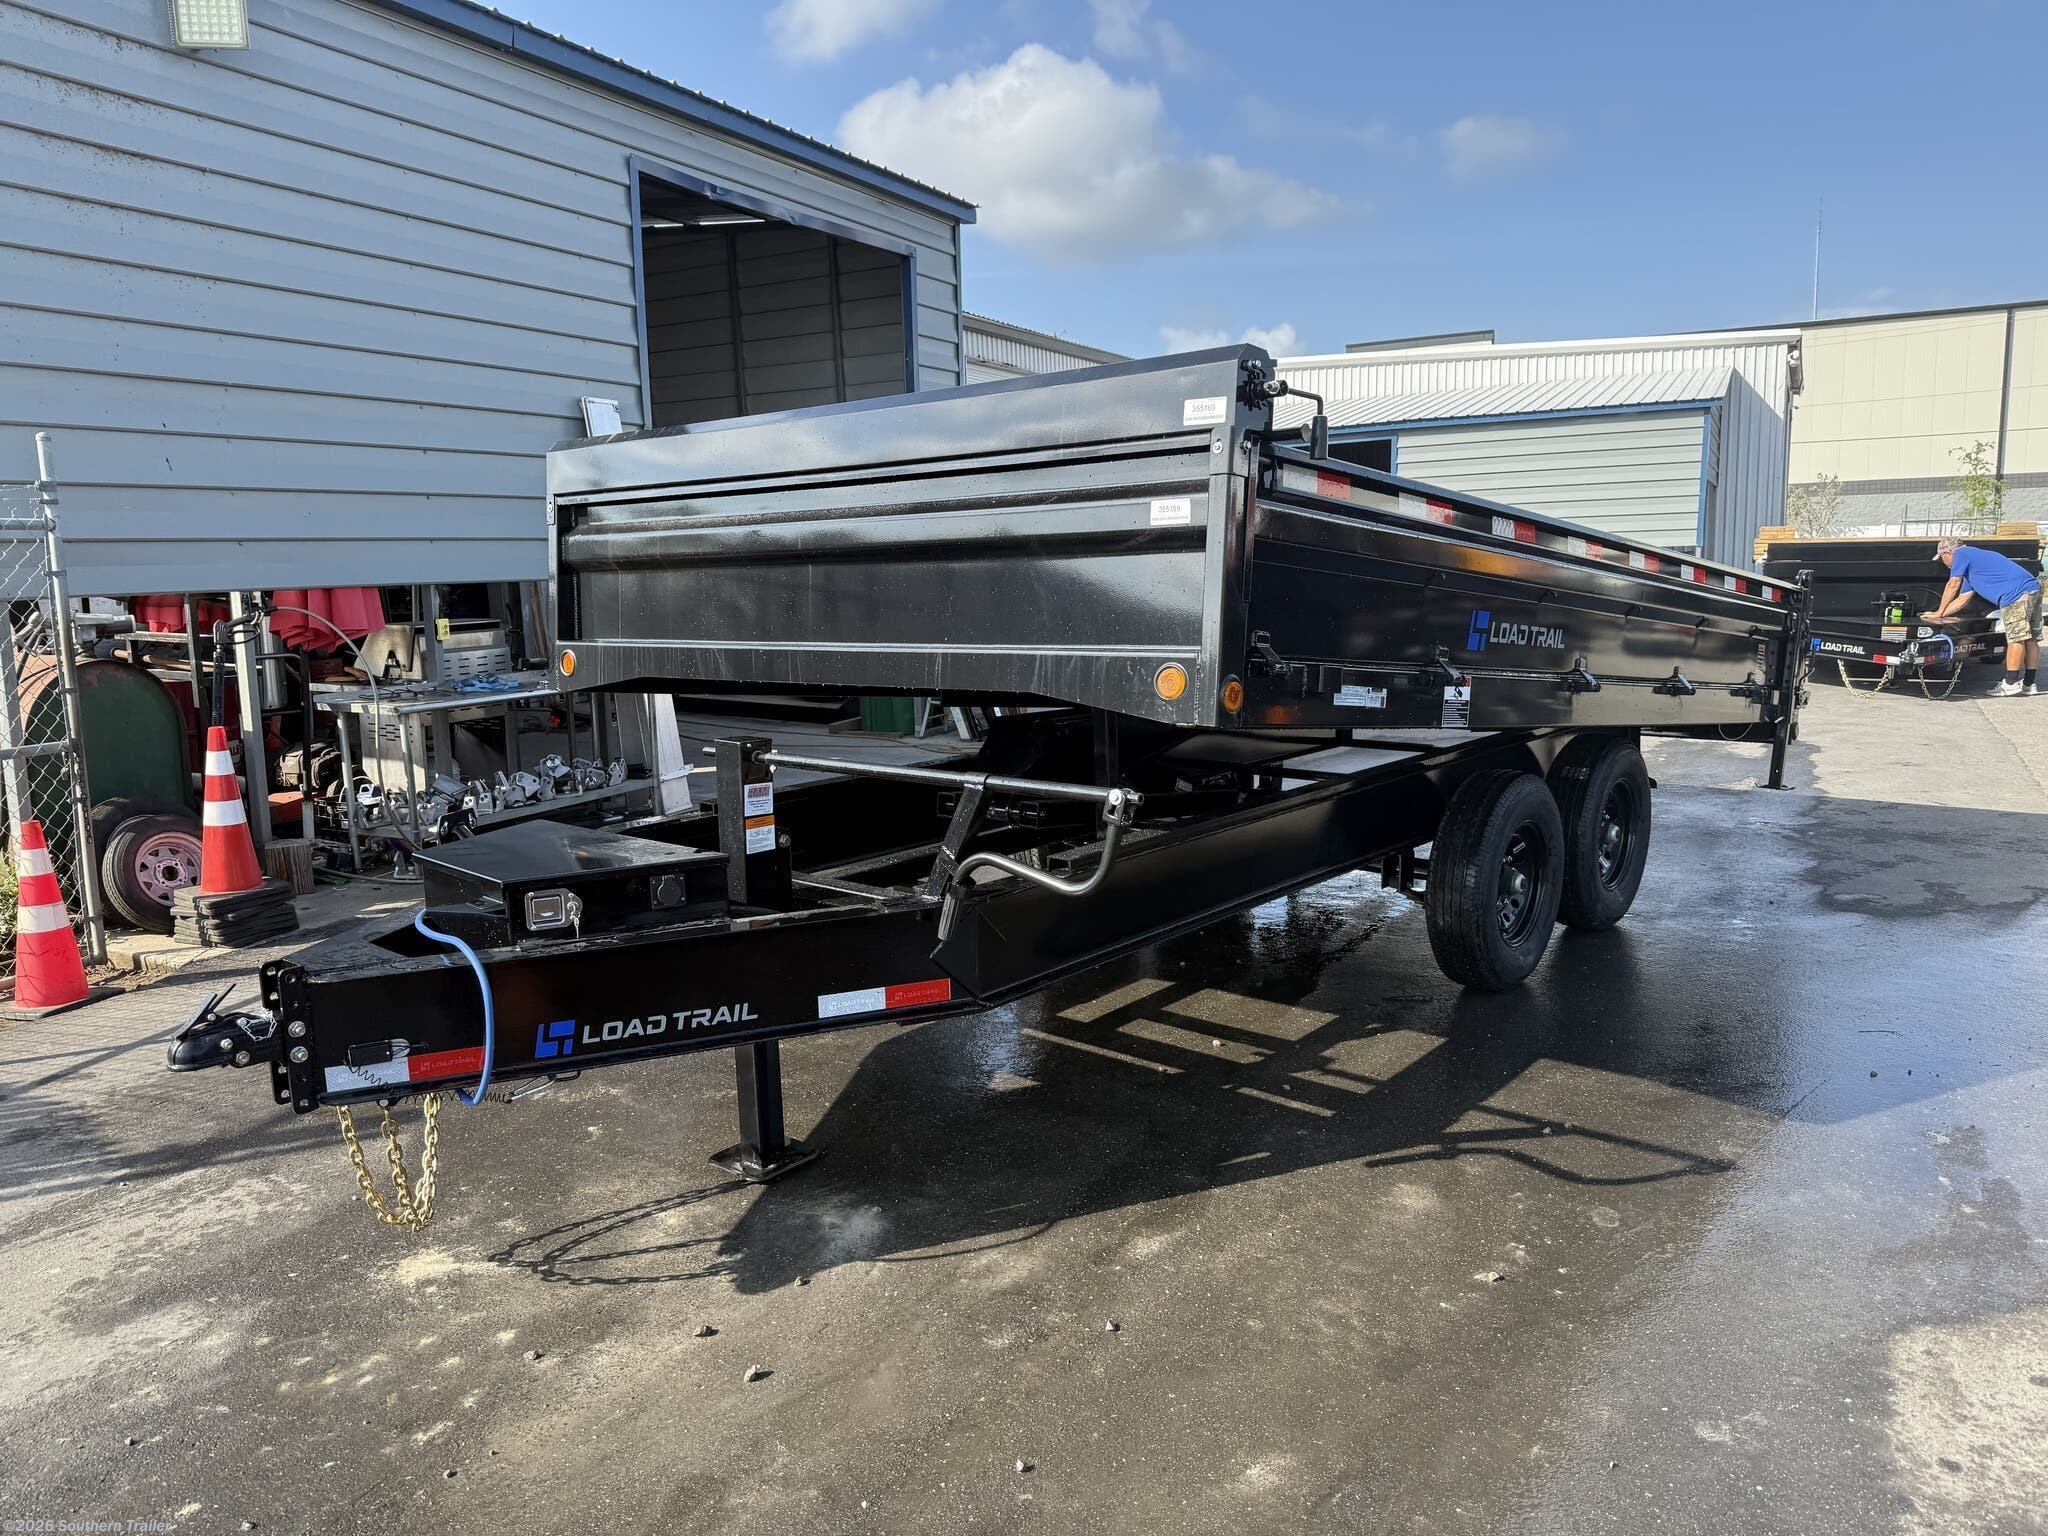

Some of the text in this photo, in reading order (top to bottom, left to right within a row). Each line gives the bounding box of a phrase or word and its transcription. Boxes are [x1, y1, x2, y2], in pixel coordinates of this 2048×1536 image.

[1490, 621, 1565, 649] LOAD TRAIL
[1821, 641, 1866, 655] LOAD TRAIL
[1953, 642, 1987, 654] OAD TRAIL
[582, 1002, 759, 1045] LOAD TRAIL
